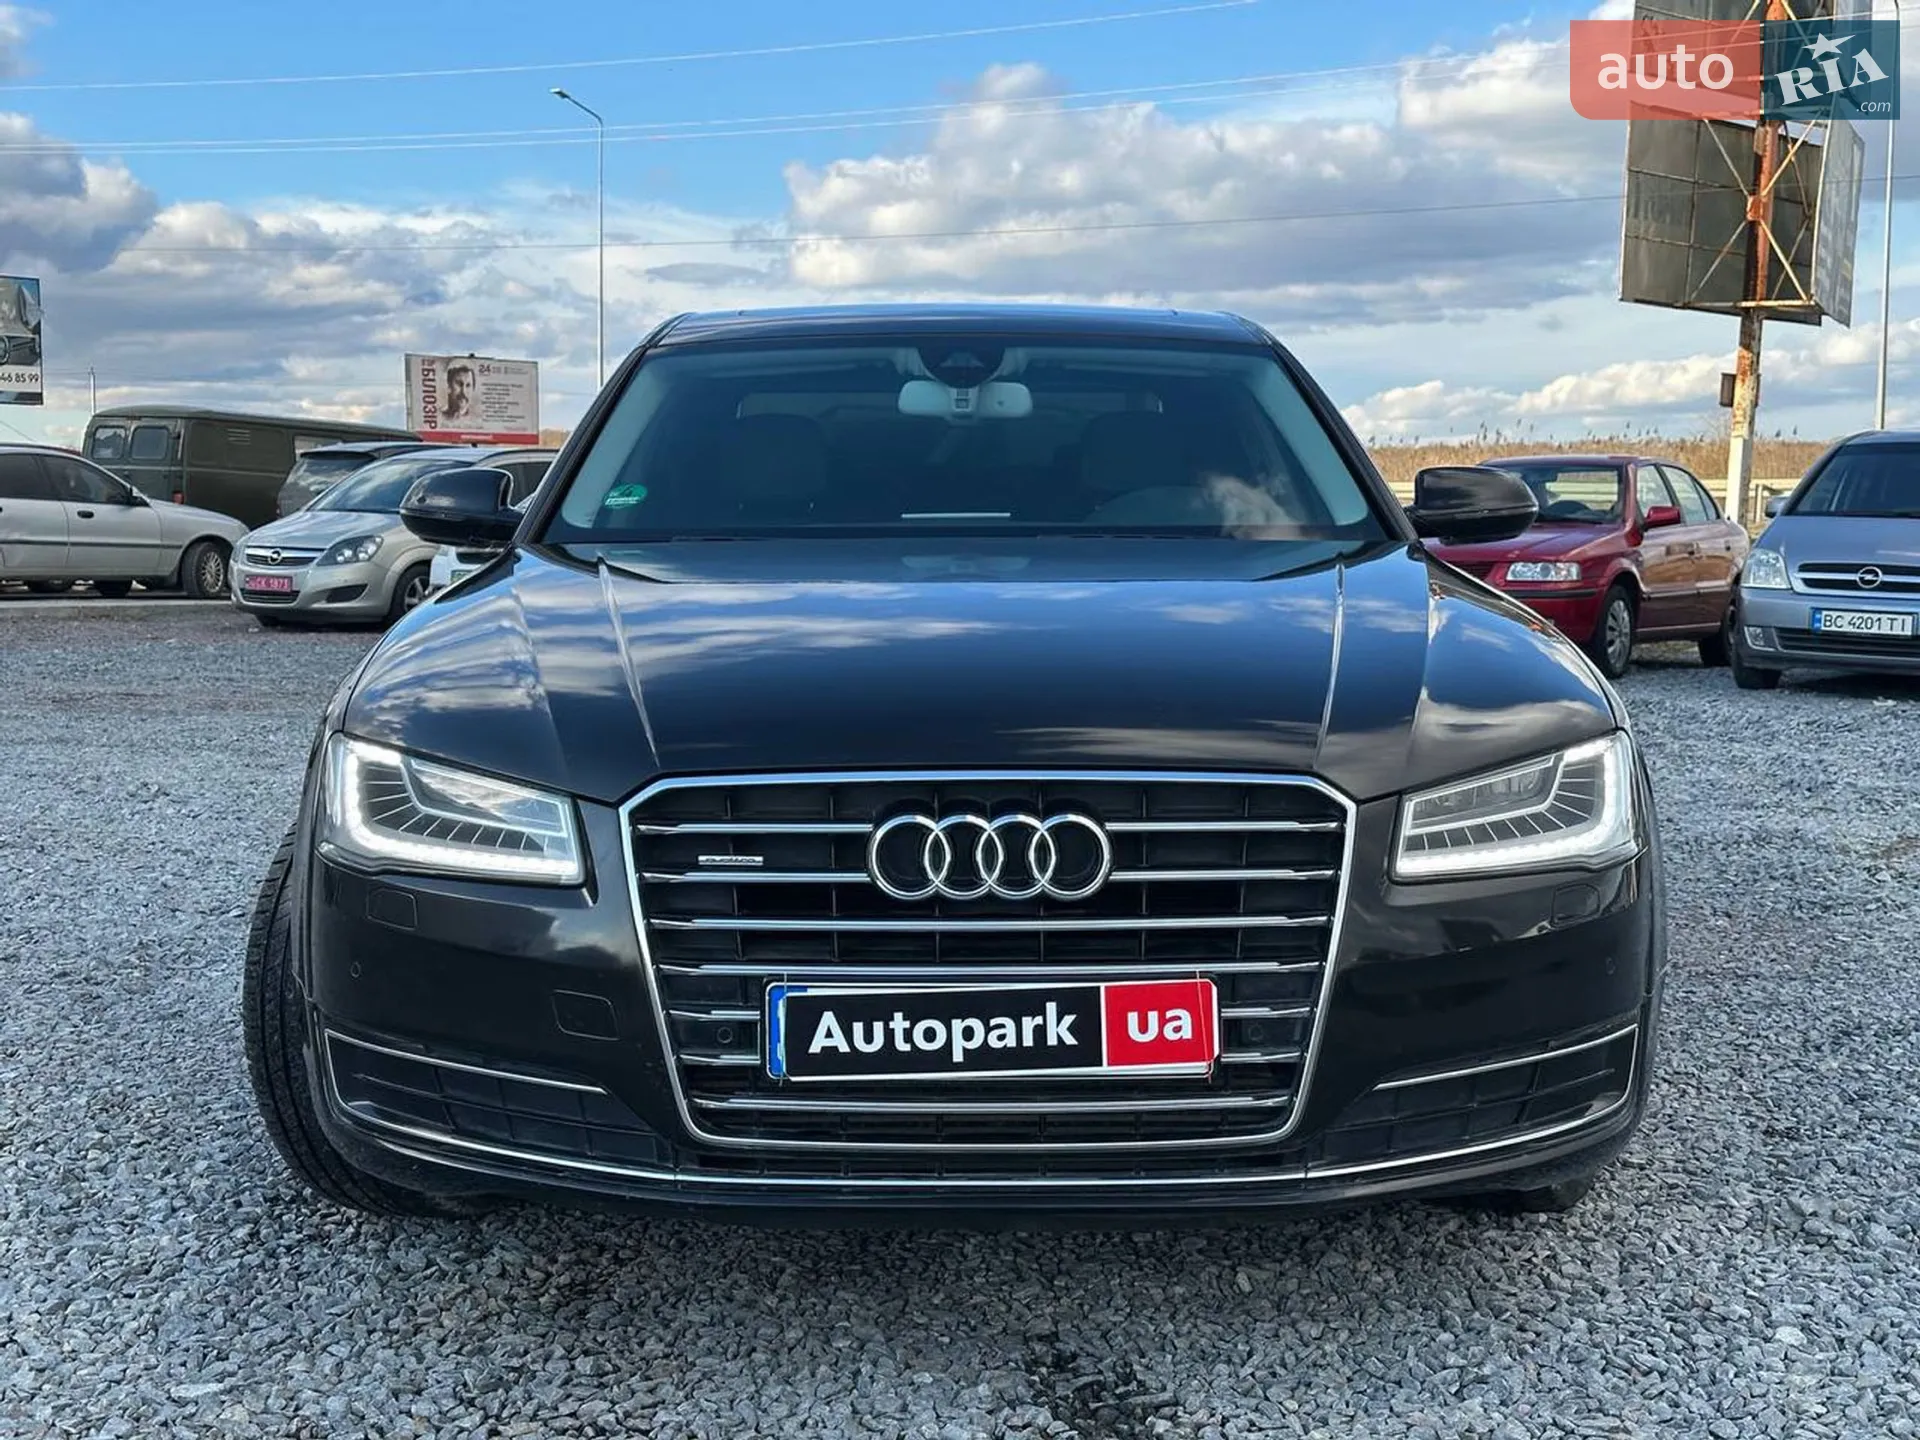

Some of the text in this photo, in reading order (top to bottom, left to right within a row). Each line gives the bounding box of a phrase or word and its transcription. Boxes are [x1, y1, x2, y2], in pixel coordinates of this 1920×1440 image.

[1823, 614, 1844, 628] BC
[1848, 616, 1882, 631] 4201
[808, 1002, 1193, 1062] Autopark ua
